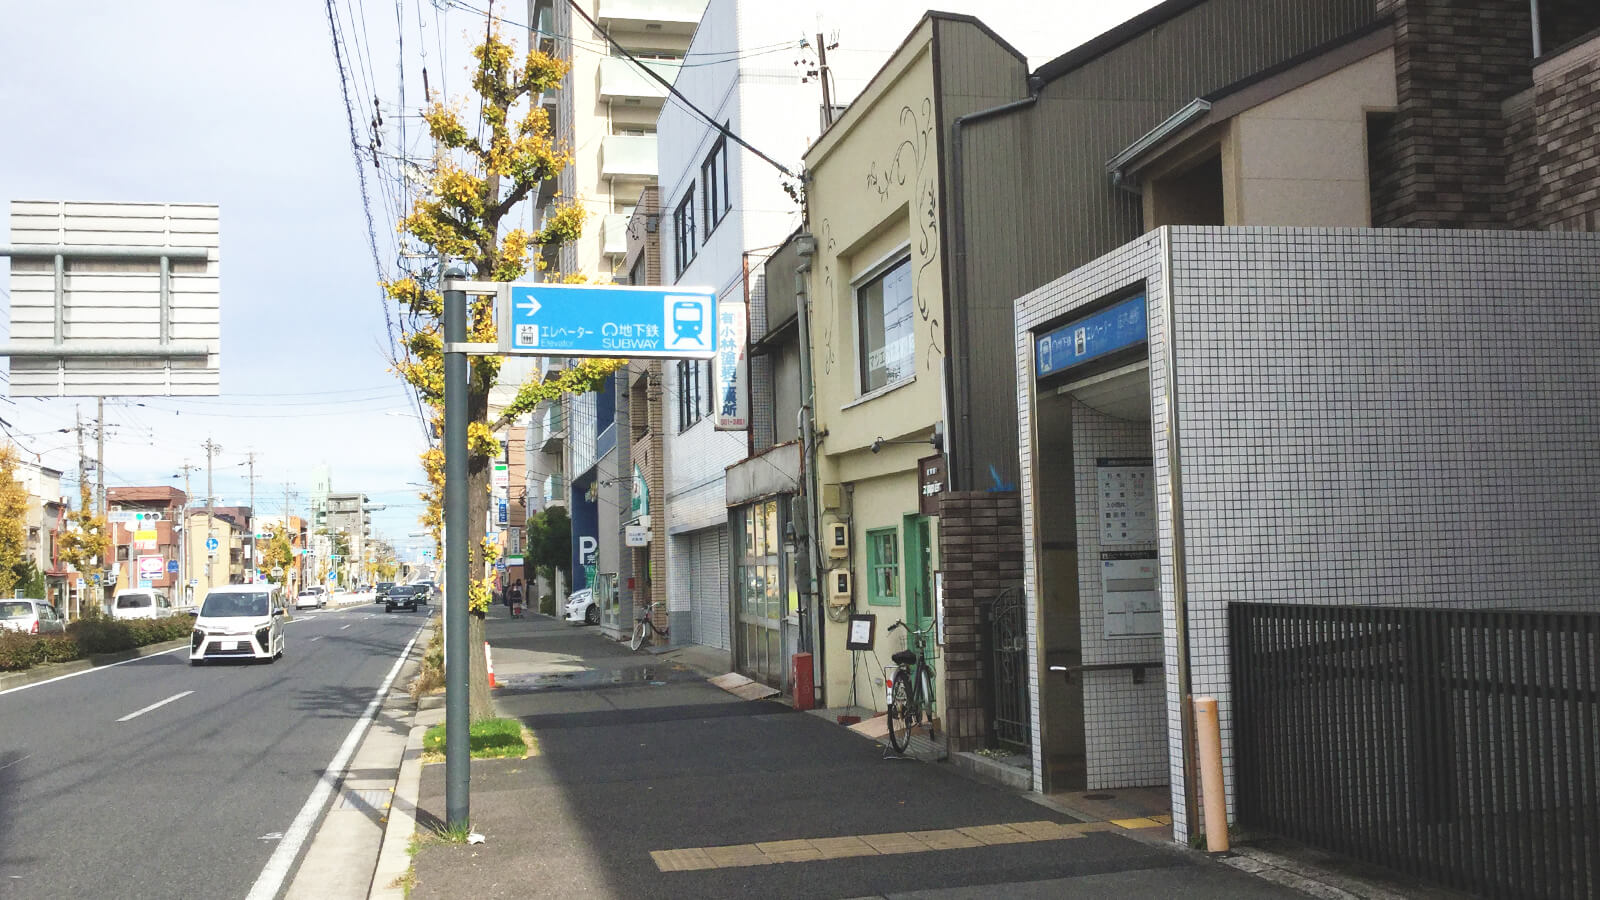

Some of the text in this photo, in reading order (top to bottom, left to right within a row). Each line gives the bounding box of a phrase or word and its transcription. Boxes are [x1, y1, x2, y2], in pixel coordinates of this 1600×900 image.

[541, 326, 594, 339] エレベーター
[619, 323, 660, 337] 地下鉄
[602, 338, 660, 349] SUBWAY
[579, 536, 598, 565] P
